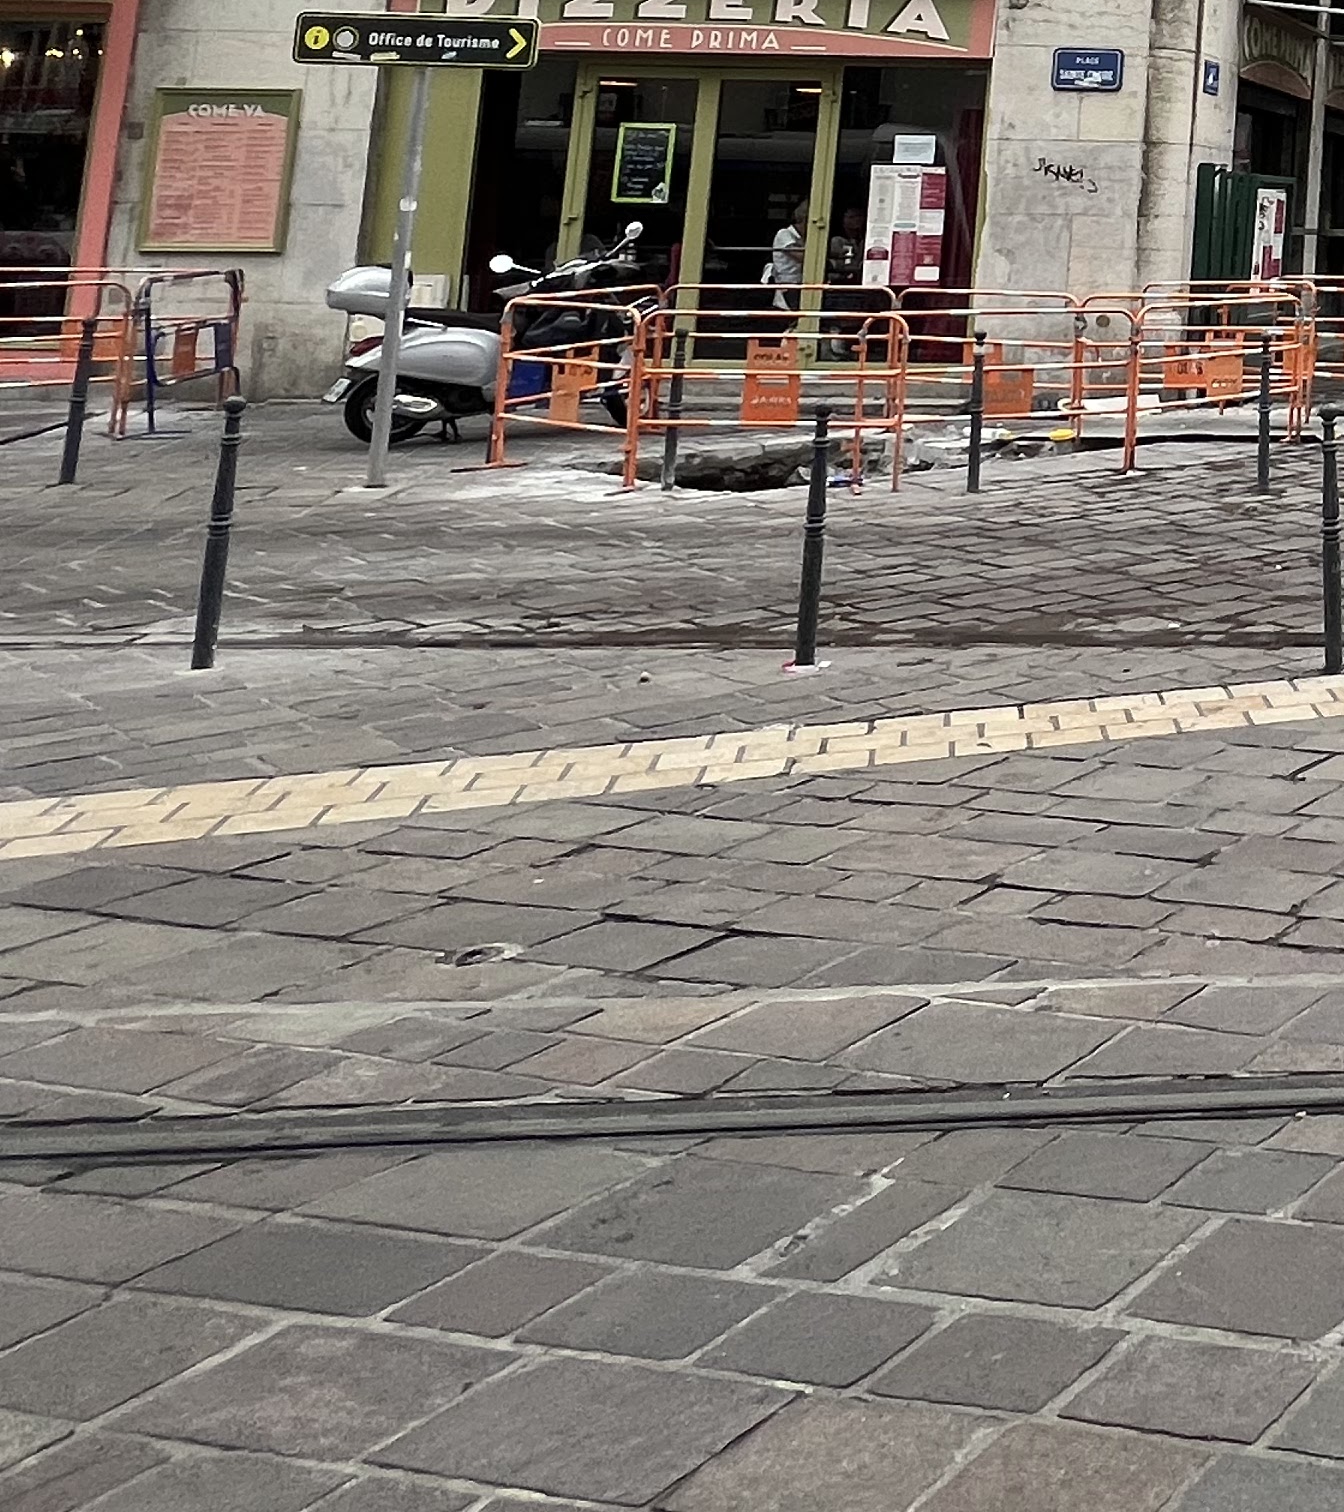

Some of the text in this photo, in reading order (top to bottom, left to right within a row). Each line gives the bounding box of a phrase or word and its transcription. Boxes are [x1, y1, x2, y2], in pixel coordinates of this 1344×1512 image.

[368, 32, 413, 48] Office
[416, 33, 433, 48] de
[437, 34, 500, 50] Tourisme
[602, 27, 780, 51] COME PRIMA
[187, 104, 238, 119] COME
